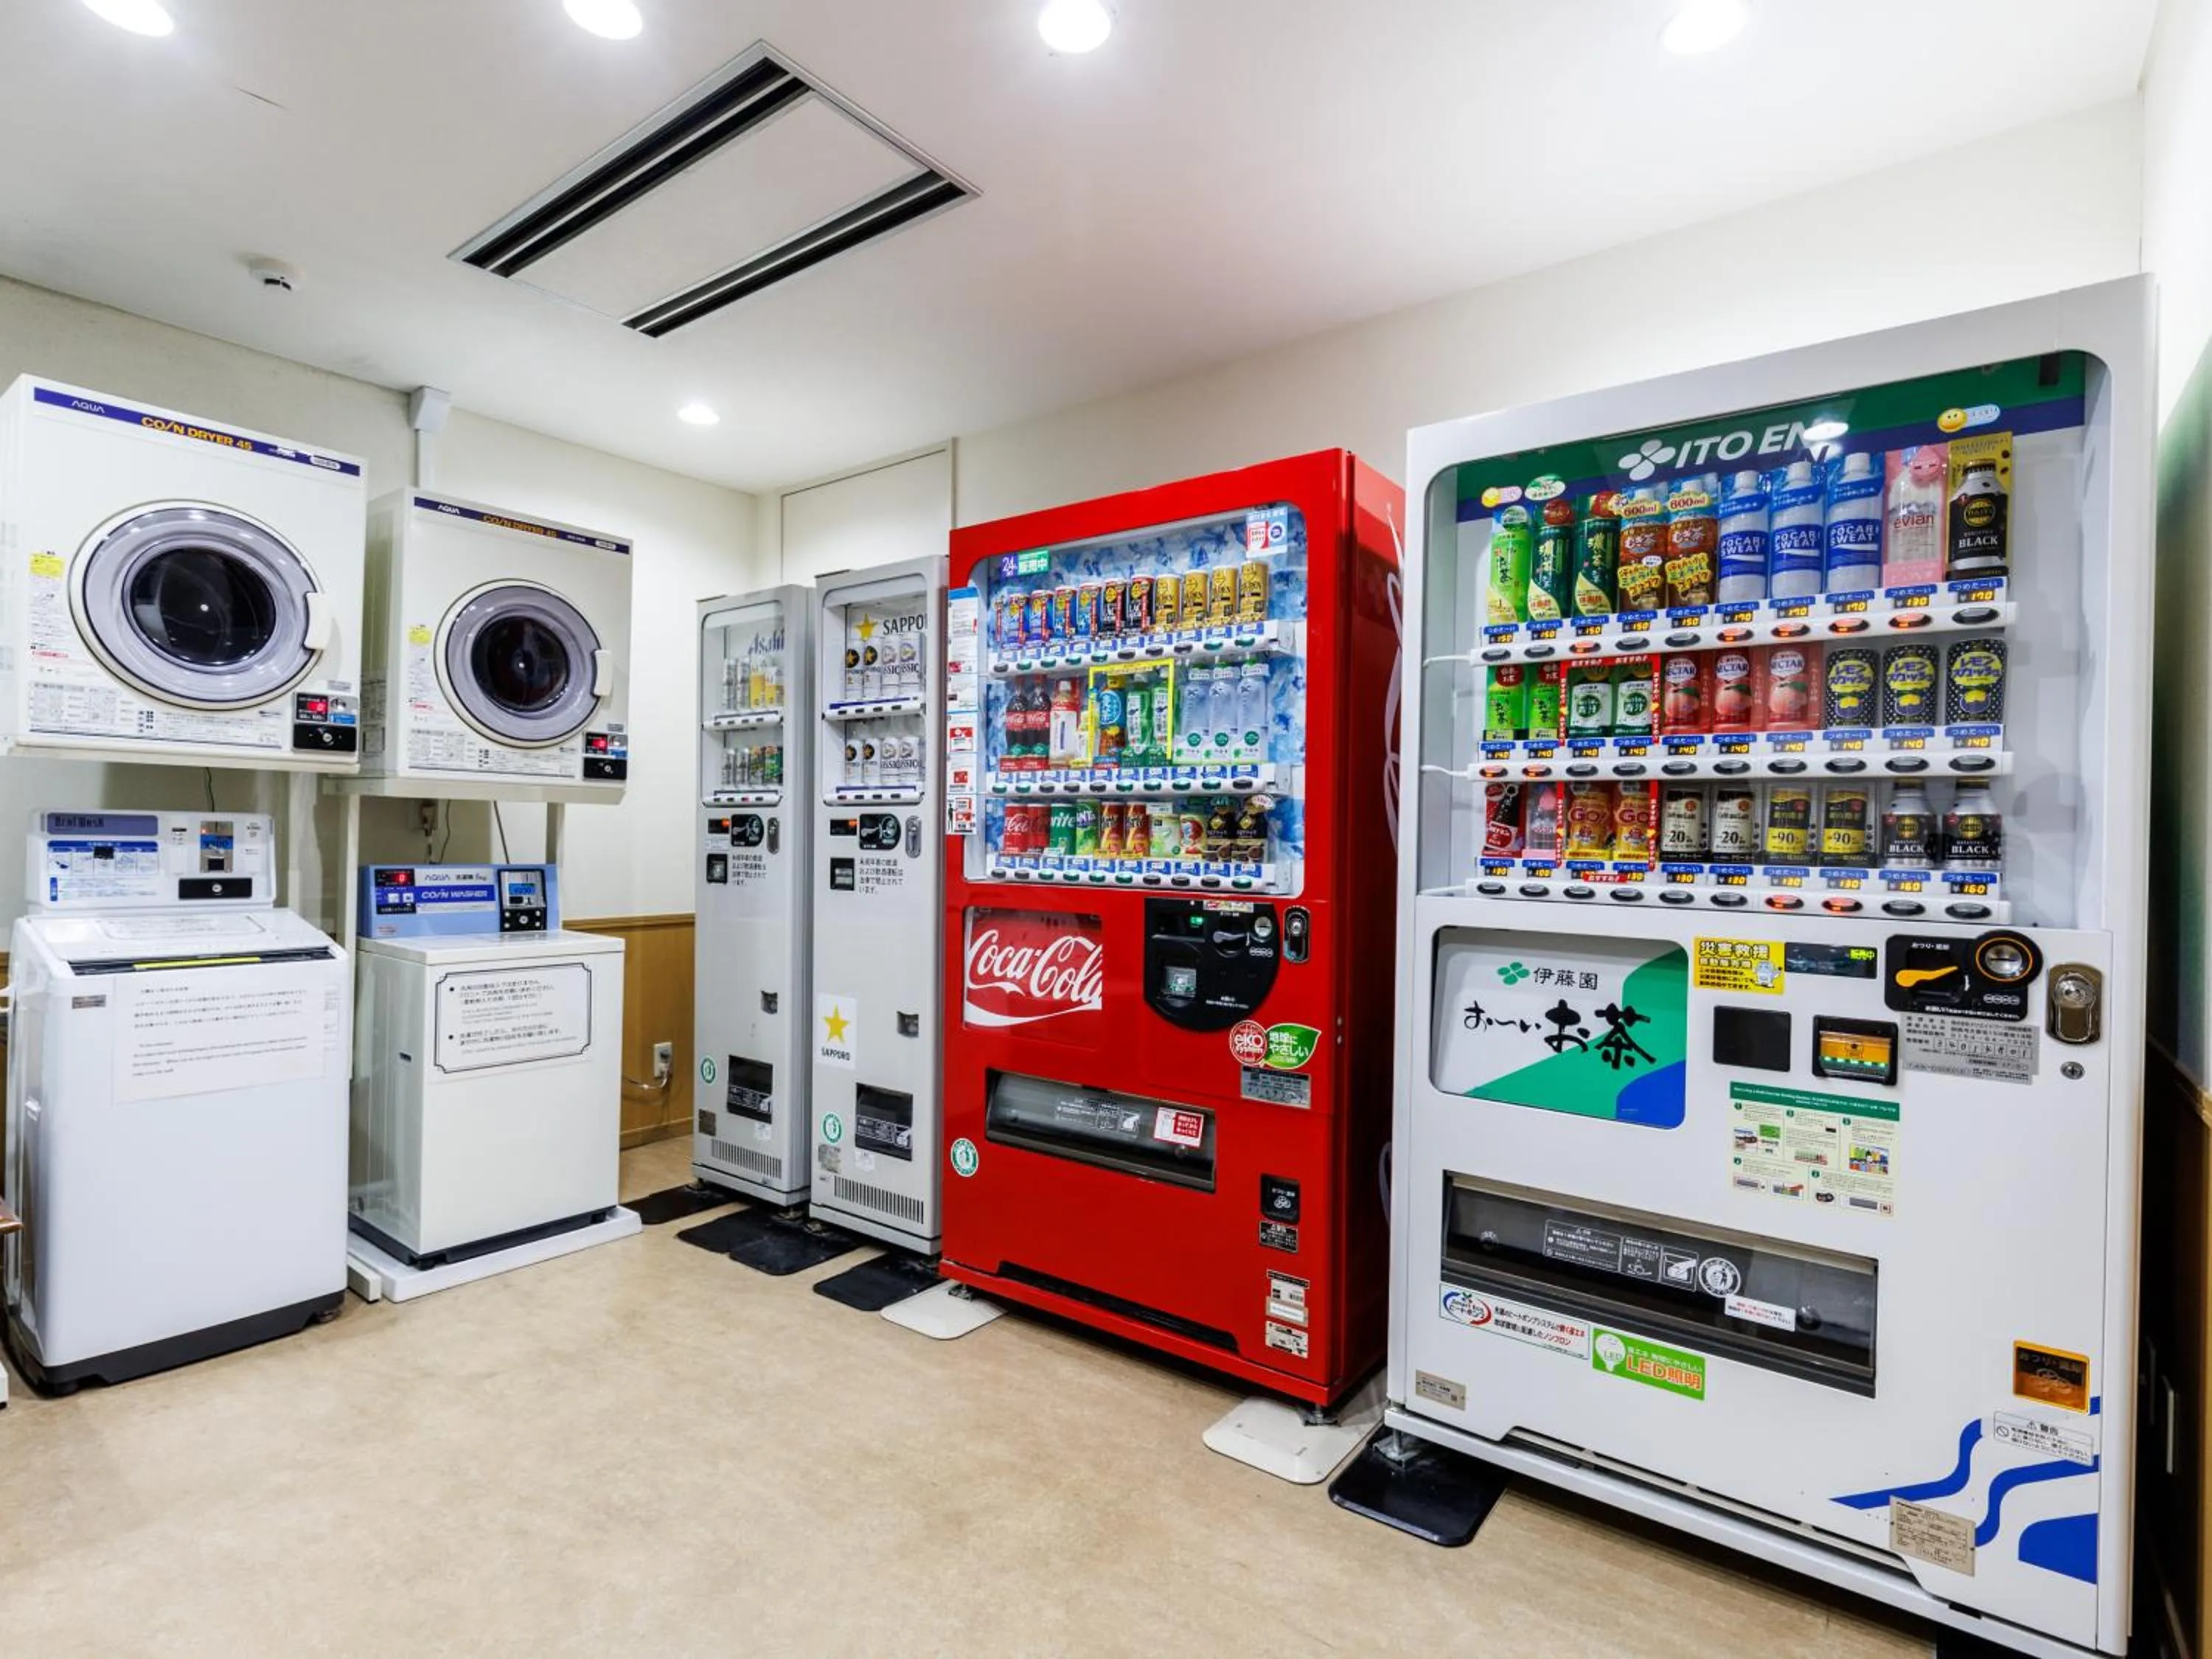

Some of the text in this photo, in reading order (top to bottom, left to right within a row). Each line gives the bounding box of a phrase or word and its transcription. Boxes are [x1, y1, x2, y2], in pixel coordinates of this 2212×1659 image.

[72, 400, 105, 414] AQUA
[187, 428, 233, 446] DRYER
[1674, 430, 1755, 468] ITO
[1670, 497, 1705, 509] 600ml
[1623, 504, 1657, 517] 600ml
[1893, 513, 1935, 529] evian
[1774, 529, 1820, 543] POCARI
[1830, 524, 1879, 537] POCARI
[1721, 534, 1765, 549] POCARI
[1775, 539, 1816, 552] SWEAT
[1830, 532, 1874, 546] SWEAT
[1958, 536, 1999, 549] BLACK
[1721, 544, 1760, 557] SWEAT
[748, 627, 785, 655] Asahi
[1889, 844, 1925, 853] BLACK
[1951, 845, 1989, 855] BLACK
[1699, 940, 1770, 960] 災害救援
[968, 929, 1102, 1004] Coca-Cola
[1699, 957, 1752, 969] 自動販売機
[1533, 966, 1599, 990] 伊藤園
[1234, 1034, 1264, 1048] eko
[821, 1046, 851, 1062] SAPPORO
[1269, 1045, 1310, 1057] やさしい
[1604, 1349, 1622, 1360] LED
[1627, 1354, 1702, 1392] LED照明
